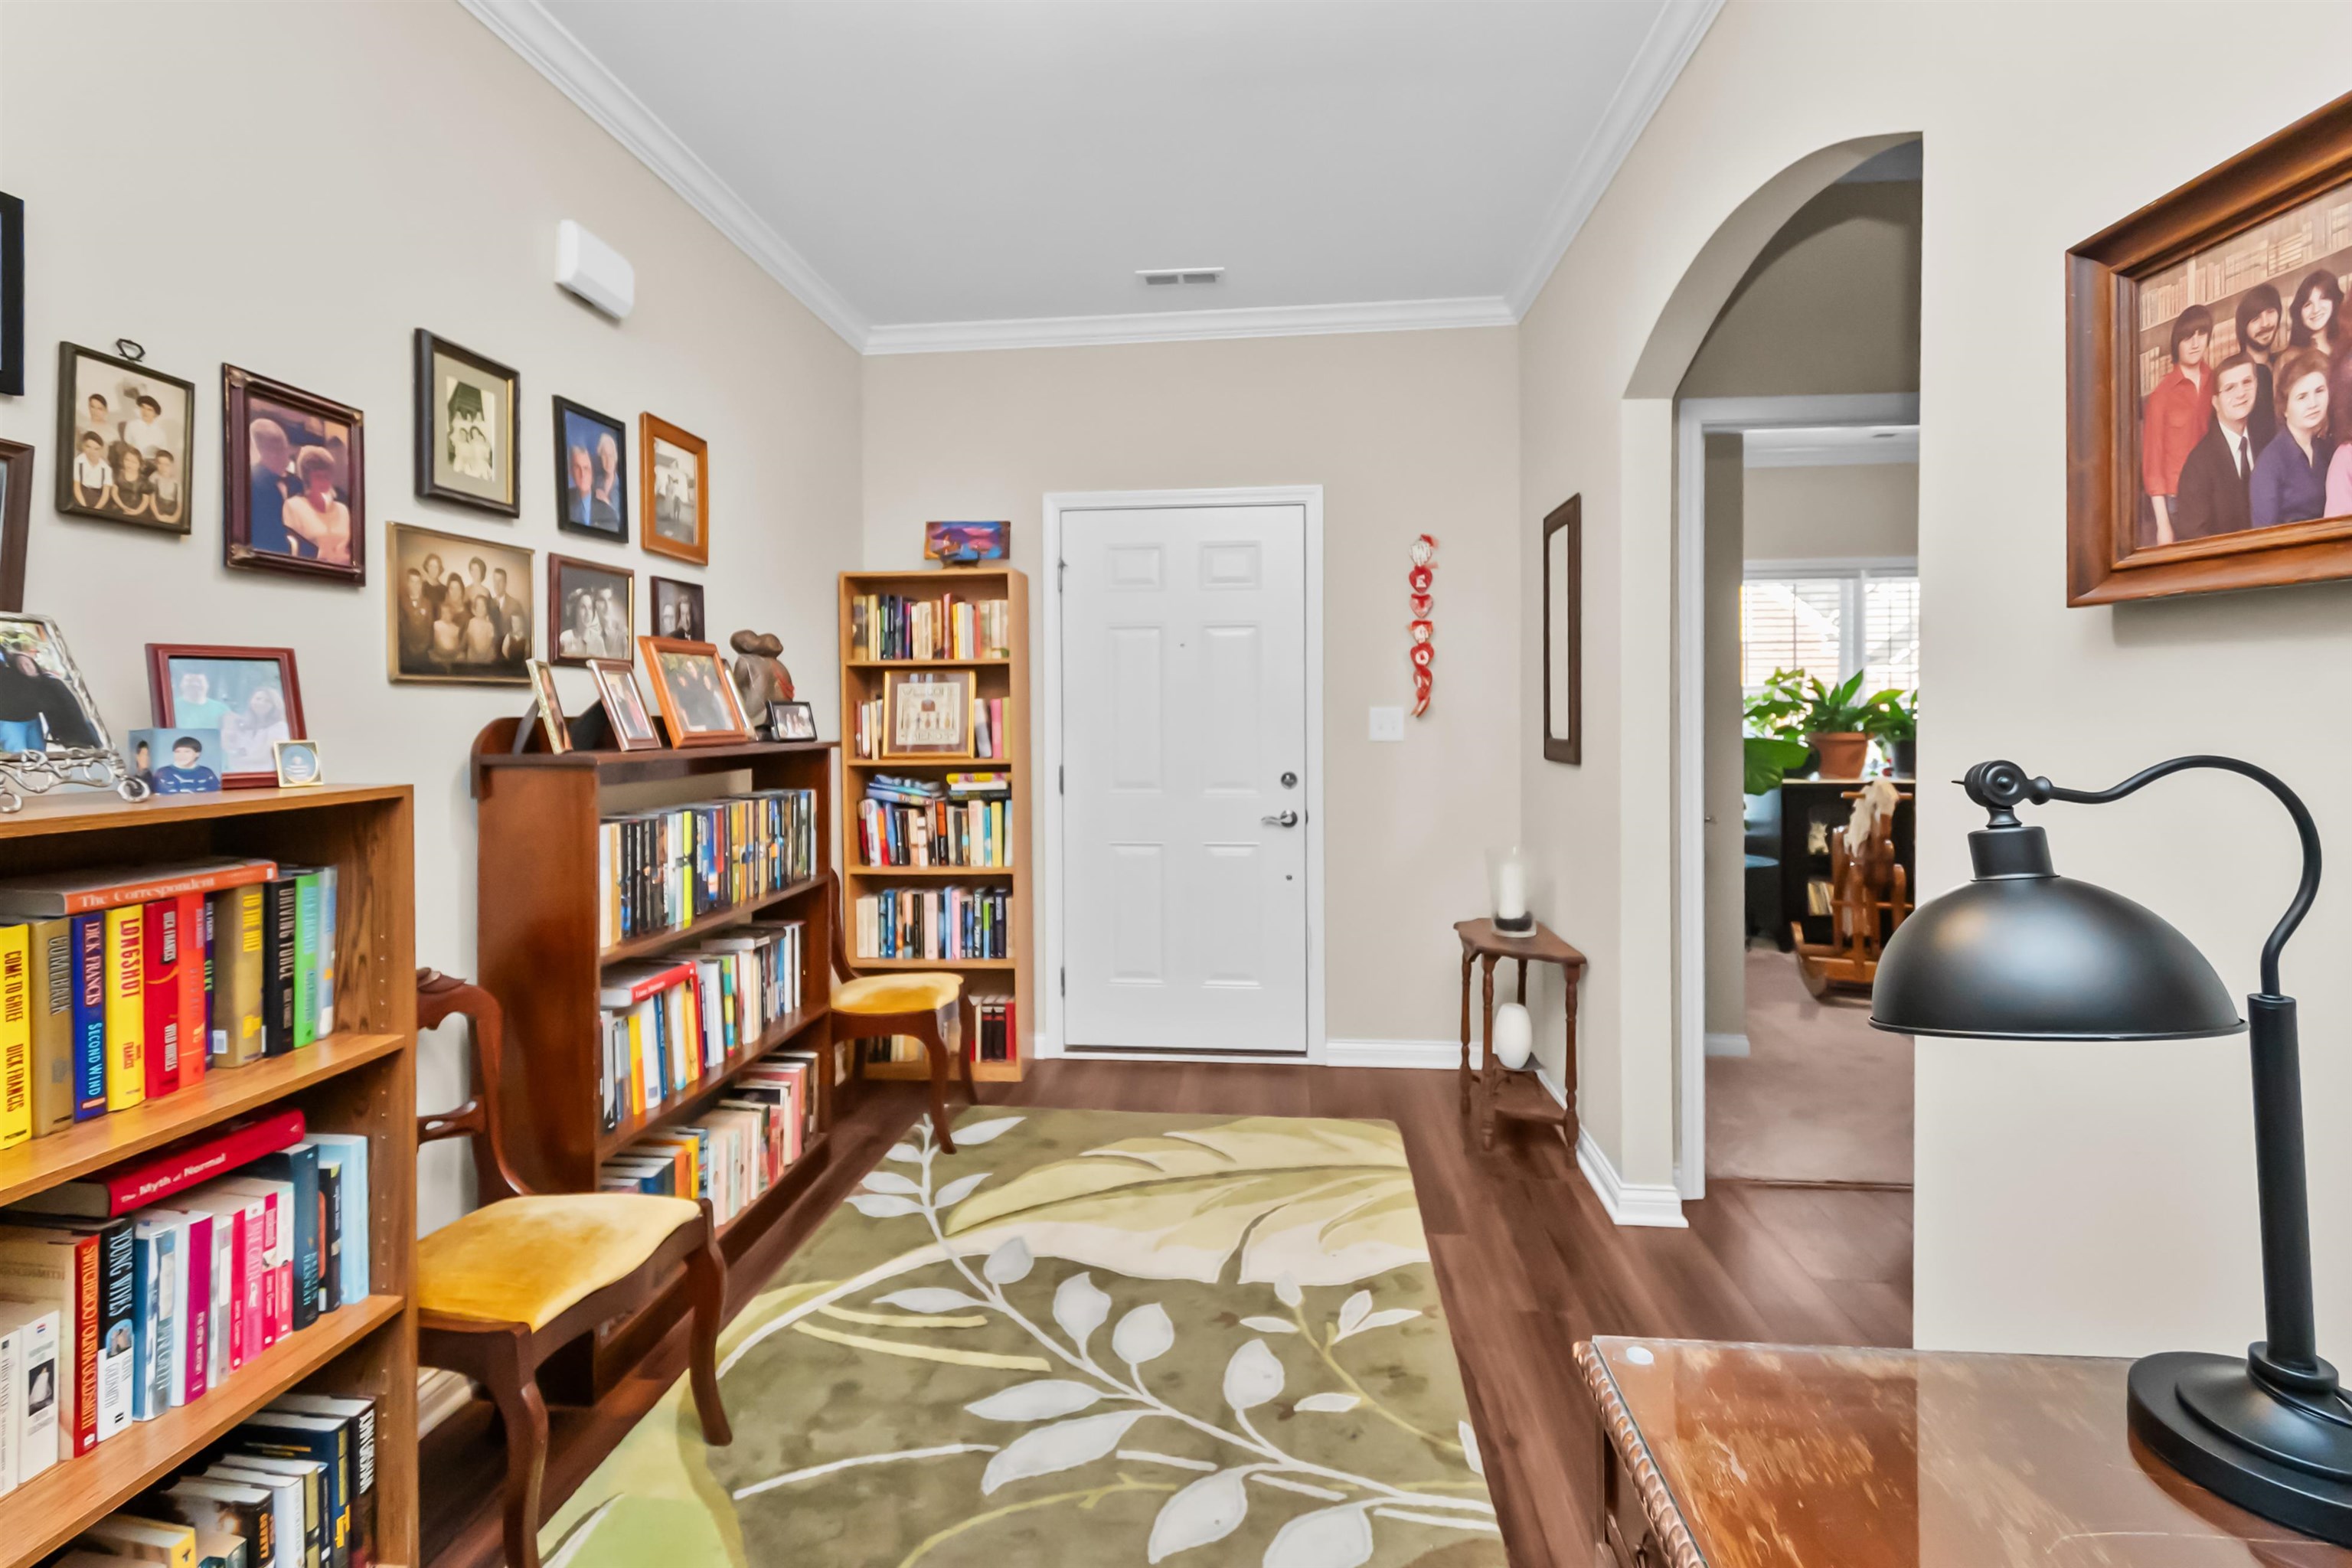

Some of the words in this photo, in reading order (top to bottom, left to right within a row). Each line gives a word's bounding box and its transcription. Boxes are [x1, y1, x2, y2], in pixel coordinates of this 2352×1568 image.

[80, 893, 108, 908] The
[113, 878, 215, 902] Correspondent
[243, 893, 261, 906] TO
[163, 910, 175, 930] DICK
[279, 888, 295, 939] DRIVING
[85, 922, 101, 952] DICK
[164, 929, 176, 962] FRANCIS
[5, 950, 22, 981] COME
[120, 918, 141, 998] LONGSHOT
[279, 942, 294, 981] FORCE
[5, 981, 23, 994] TO
[49, 936, 71, 1016] COMEBACK
[85, 956, 101, 1006] FRANCIS
[5, 995, 23, 1023] GRIEF
[88, 1022, 103, 1063] SECOND
[165, 1023, 177, 1044] WILD
[6, 1044, 24, 1068] DICK
[123, 1041, 134, 1070] FRANCIS
[165, 1044, 177, 1072] HORSES
[7, 1067, 24, 1112] FRANCIS
[88, 1064, 103, 1096] WIND
[139, 1176, 172, 1196] Myth
[184, 1153, 226, 1177] Normal
[109, 1227, 132, 1277] YOUNG
[82, 1245, 98, 1321] SWITCHEROO
[109, 1276, 132, 1318] WIVES
[82, 1325, 98, 1362] OLIVIA
[82, 1362, 98, 1430] GOLDSMITH
[359, 1409, 374, 1442] JOHN
[359, 1438, 374, 1494] GRISHAM
